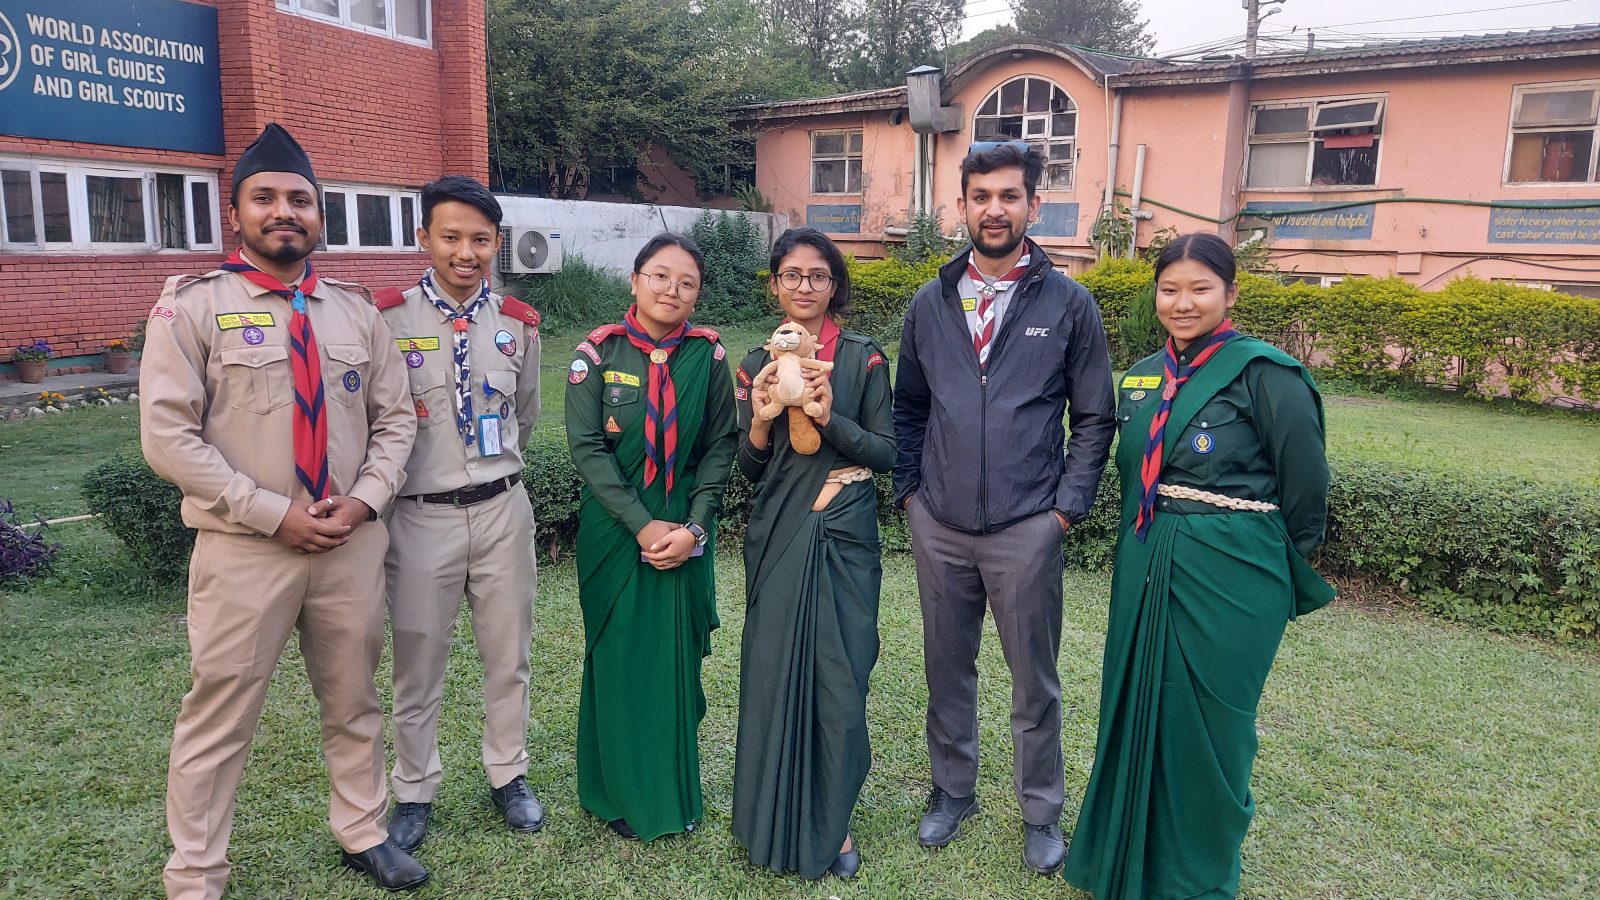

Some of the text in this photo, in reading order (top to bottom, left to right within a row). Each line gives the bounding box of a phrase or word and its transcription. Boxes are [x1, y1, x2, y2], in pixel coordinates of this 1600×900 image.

[26, 13, 205, 65] WORLD ASSOCIATION
[30, 44, 166, 85] OF GIRL GUIDES
[33, 74, 186, 114] AND GIRL SCOUTS
[1286, 215, 1295, 226] is
[1295, 214, 1320, 226] useful
[1320, 214, 1337, 226] and
[1337, 213, 1368, 230] helpful.
[1494, 216, 1519, 226] sister
[1519, 216, 1528, 226] to
[1528, 217, 1552, 229] every
[1552, 216, 1576, 226] other
[1495, 230, 1516, 239] cast
[1516, 230, 1545, 239] colour
[1545, 231, 1555, 239] or
[1025, 327, 1050, 337] UFC
